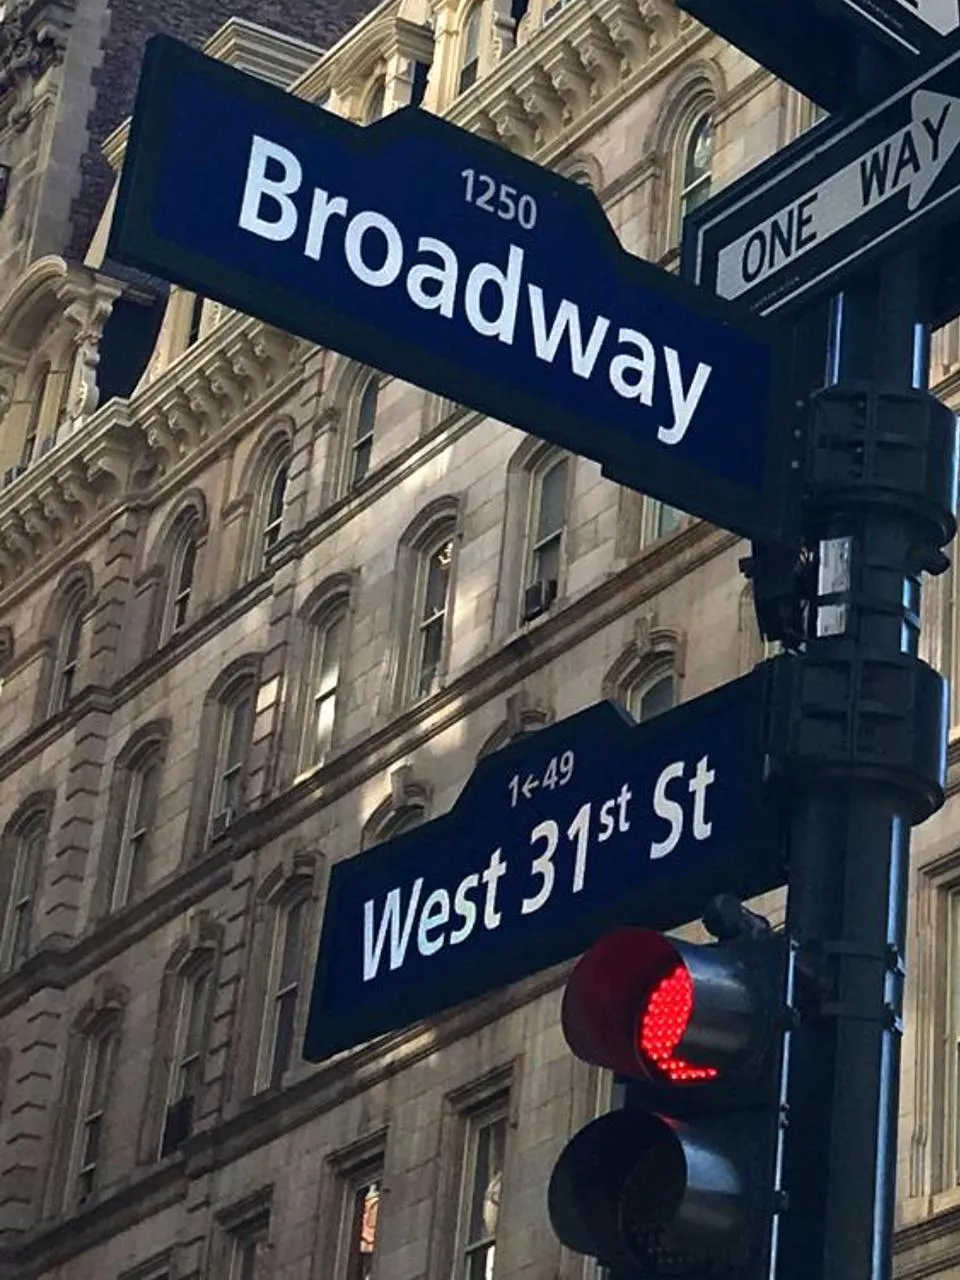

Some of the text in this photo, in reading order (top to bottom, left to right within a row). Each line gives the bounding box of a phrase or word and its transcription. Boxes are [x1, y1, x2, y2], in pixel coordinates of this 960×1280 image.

[238, 135, 712, 445] Broadway
[461, 168, 537, 230] 1250
[742, 102, 951, 283] ONE WAY
[362, 754, 716, 982] West 31st St
